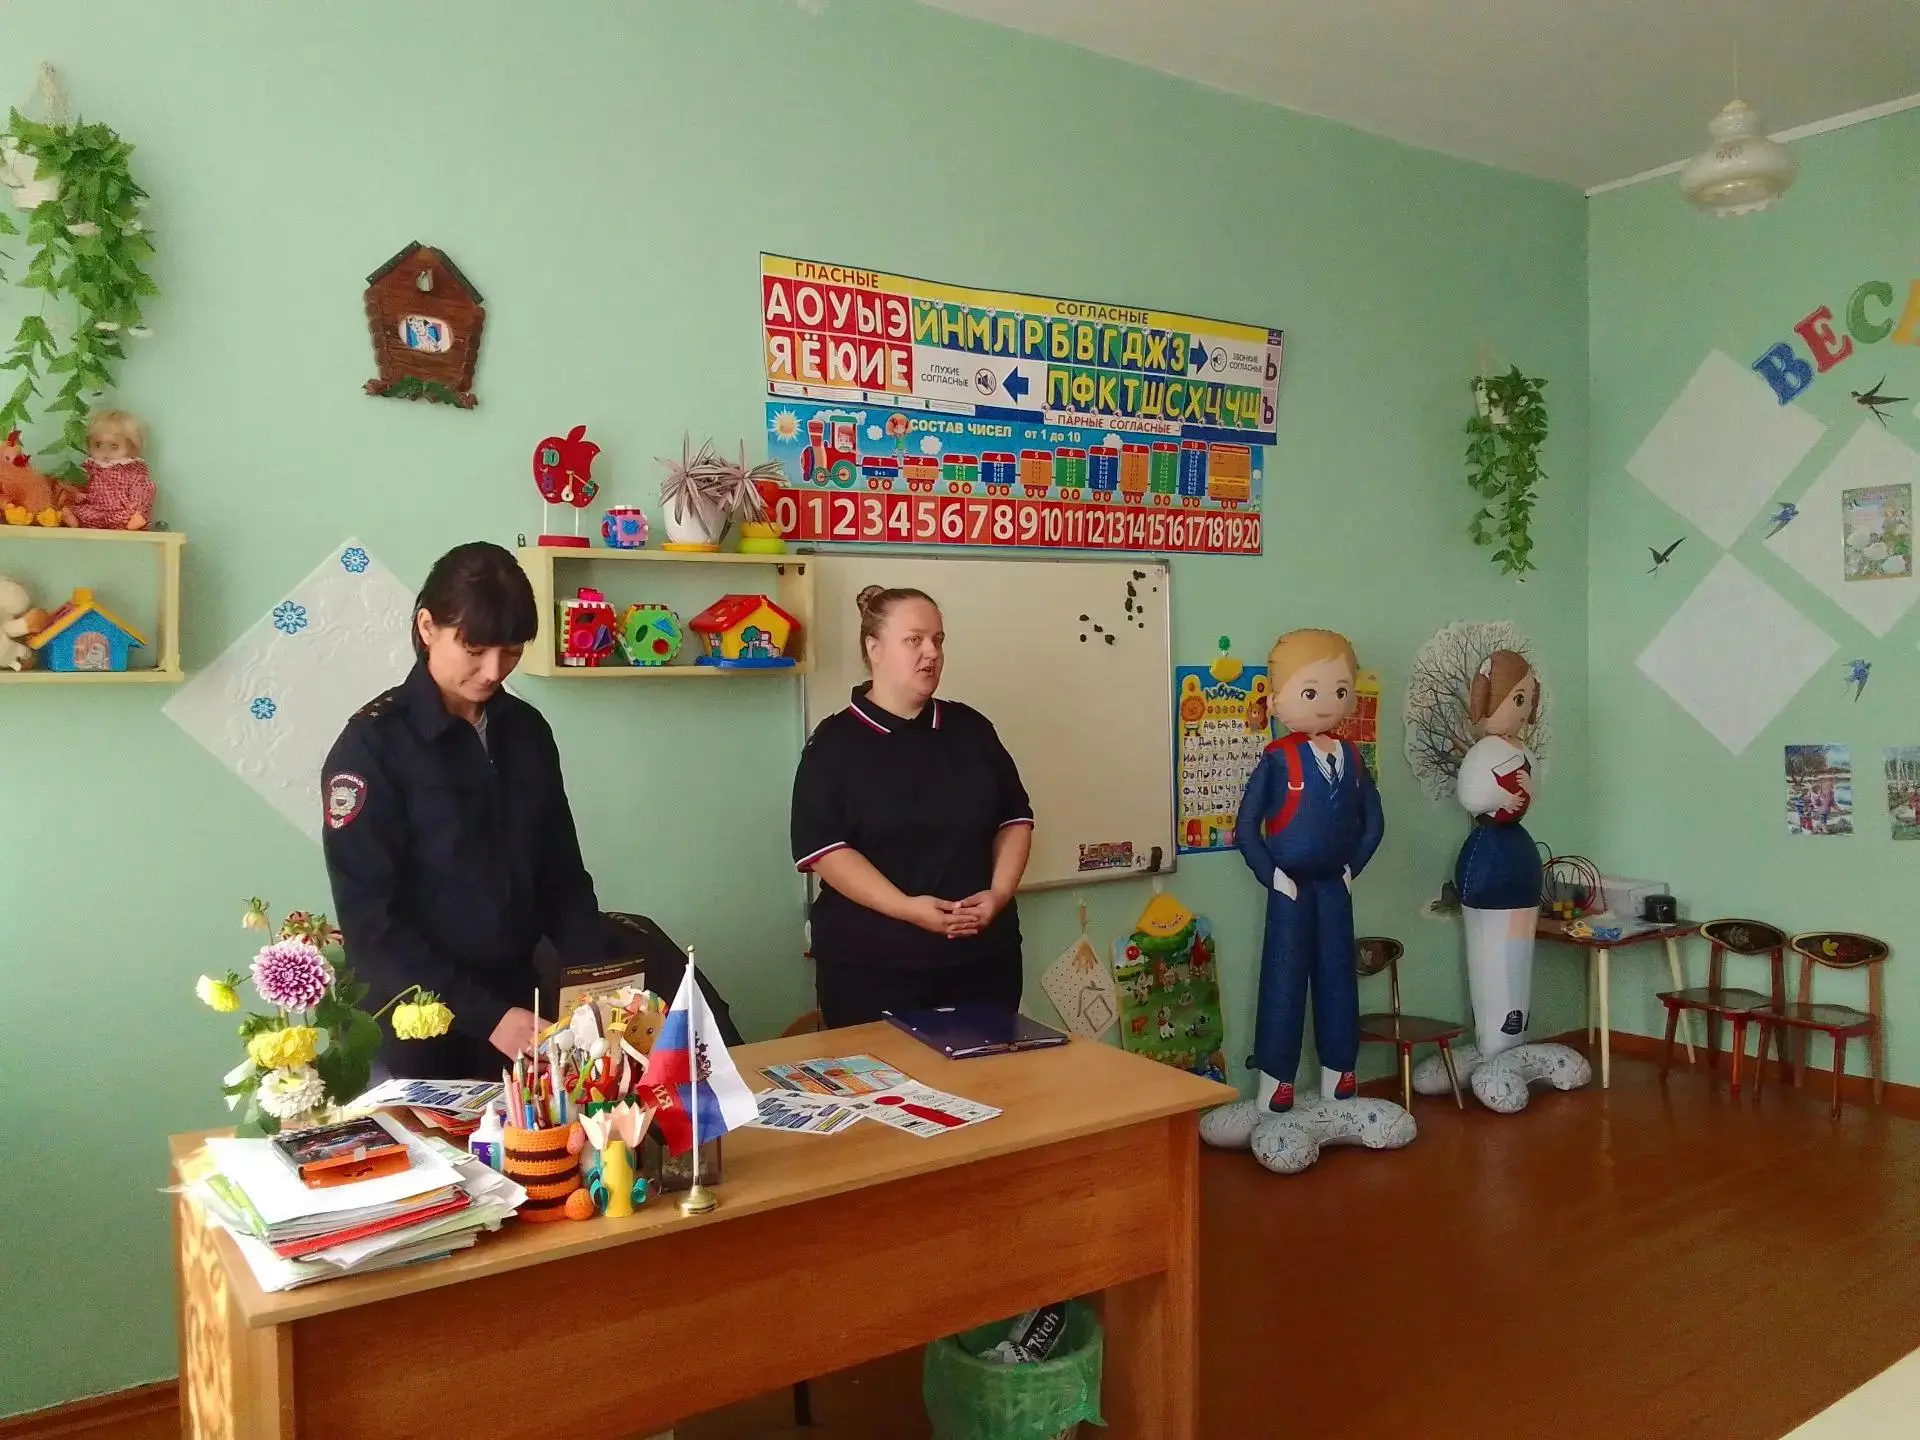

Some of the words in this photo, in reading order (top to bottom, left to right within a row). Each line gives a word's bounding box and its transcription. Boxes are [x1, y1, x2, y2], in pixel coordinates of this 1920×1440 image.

[796, 262, 879, 288] ГЛАСНЫЕ
[1056, 302, 1149, 324] СОГЛАСНЫЕ
[921, 373, 969, 387] СОГЛАСНЫЕ
[930, 364, 960, 375] ГЛУХИЕ
[910, 418, 964, 434] СОСТАВ
[968, 423, 1012, 438] ЧИСЕЛ
[1024, 430, 1037, 439] от
[1040, 429, 1047, 440] 1
[1050, 432, 1064, 442] до
[1067, 431, 1081, 443] 10
[1057, 414, 1104, 428] ПАРНЫЕ
[1109, 419, 1171, 433] СОГЛАСНЫЕ
[543, 448, 560, 466] 10
[775, 496, 797, 533] 0
[807, 498, 823, 535] 1
[833, 498, 856, 535] 2
[863, 499, 884, 536] 3
[888, 501, 911, 537] 4
[916, 502, 936, 537] 5
[941, 502, 964, 538] 6
[968, 504, 989, 539] 7
[993, 504, 1014, 540] 8
[1019, 506, 1038, 541] 9
[1041, 507, 1063, 542] 10
[1064, 509, 1083, 542] 11
[1085, 510, 1105, 543] 12
[1106, 511, 1125, 544] 13
[1126, 512, 1145, 545] 14
[1147, 513, 1165, 546] 15
[1167, 514, 1184, 546] 16
[1186, 516, 1206, 547] 17
[1206, 516, 1224, 548] 18
[1225, 518, 1243, 549] 19
[1243, 518, 1260, 549] 20
[1026, 1313, 1059, 1348] Rich
